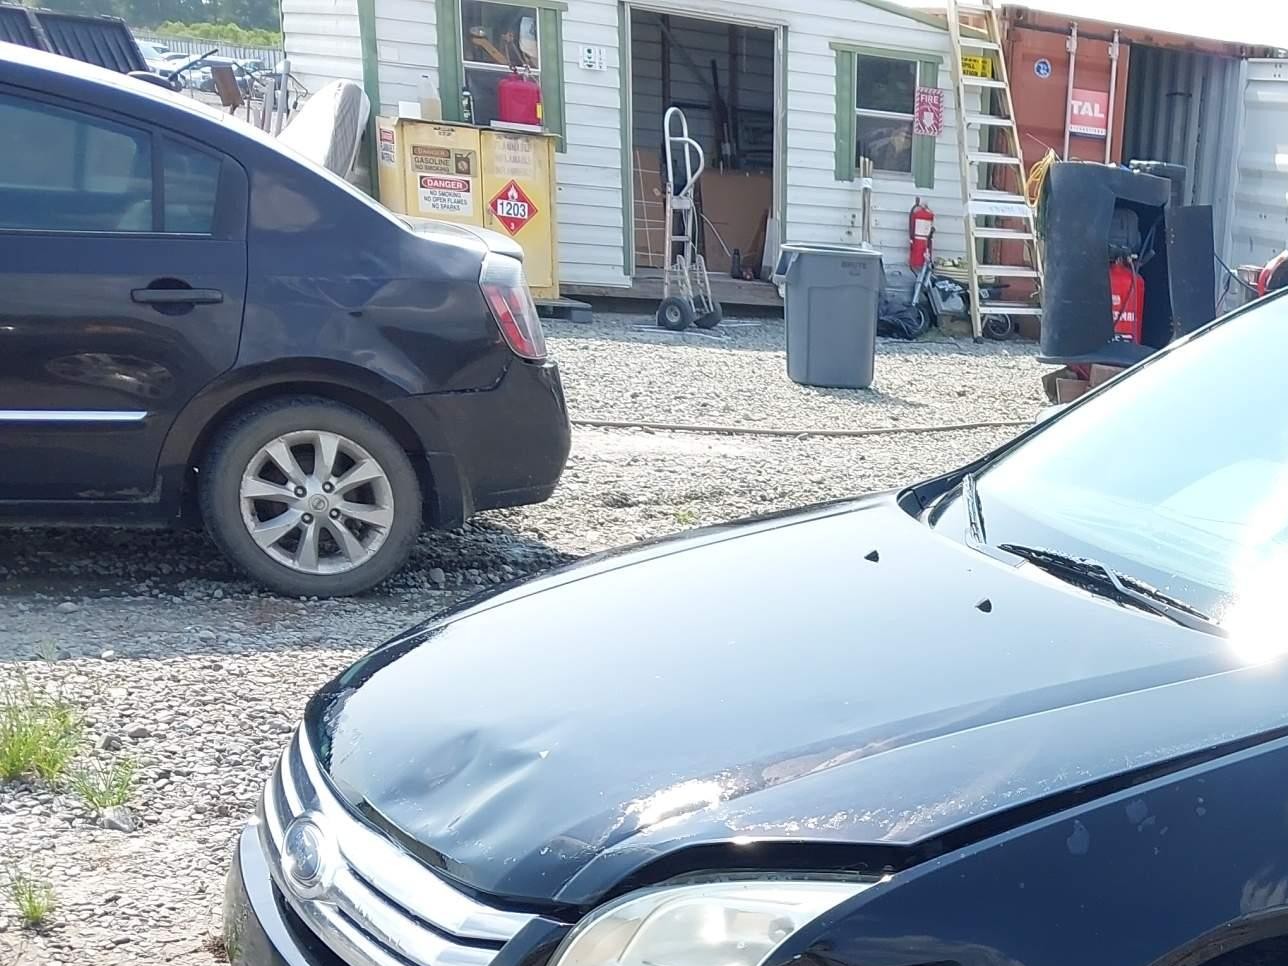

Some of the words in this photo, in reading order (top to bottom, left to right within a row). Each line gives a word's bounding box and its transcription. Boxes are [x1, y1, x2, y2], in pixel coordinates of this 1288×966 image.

[920, 95, 940, 104] FIRE
[1071, 100, 1105, 118] TAL
[414, 157, 449, 167] GASOLINE
[424, 165, 450, 173] SMOKING
[427, 180, 463, 189] DANGER
[440, 203, 461, 211] SPARKS
[500, 201, 526, 218] 1203
[510, 222, 515, 230] 3
